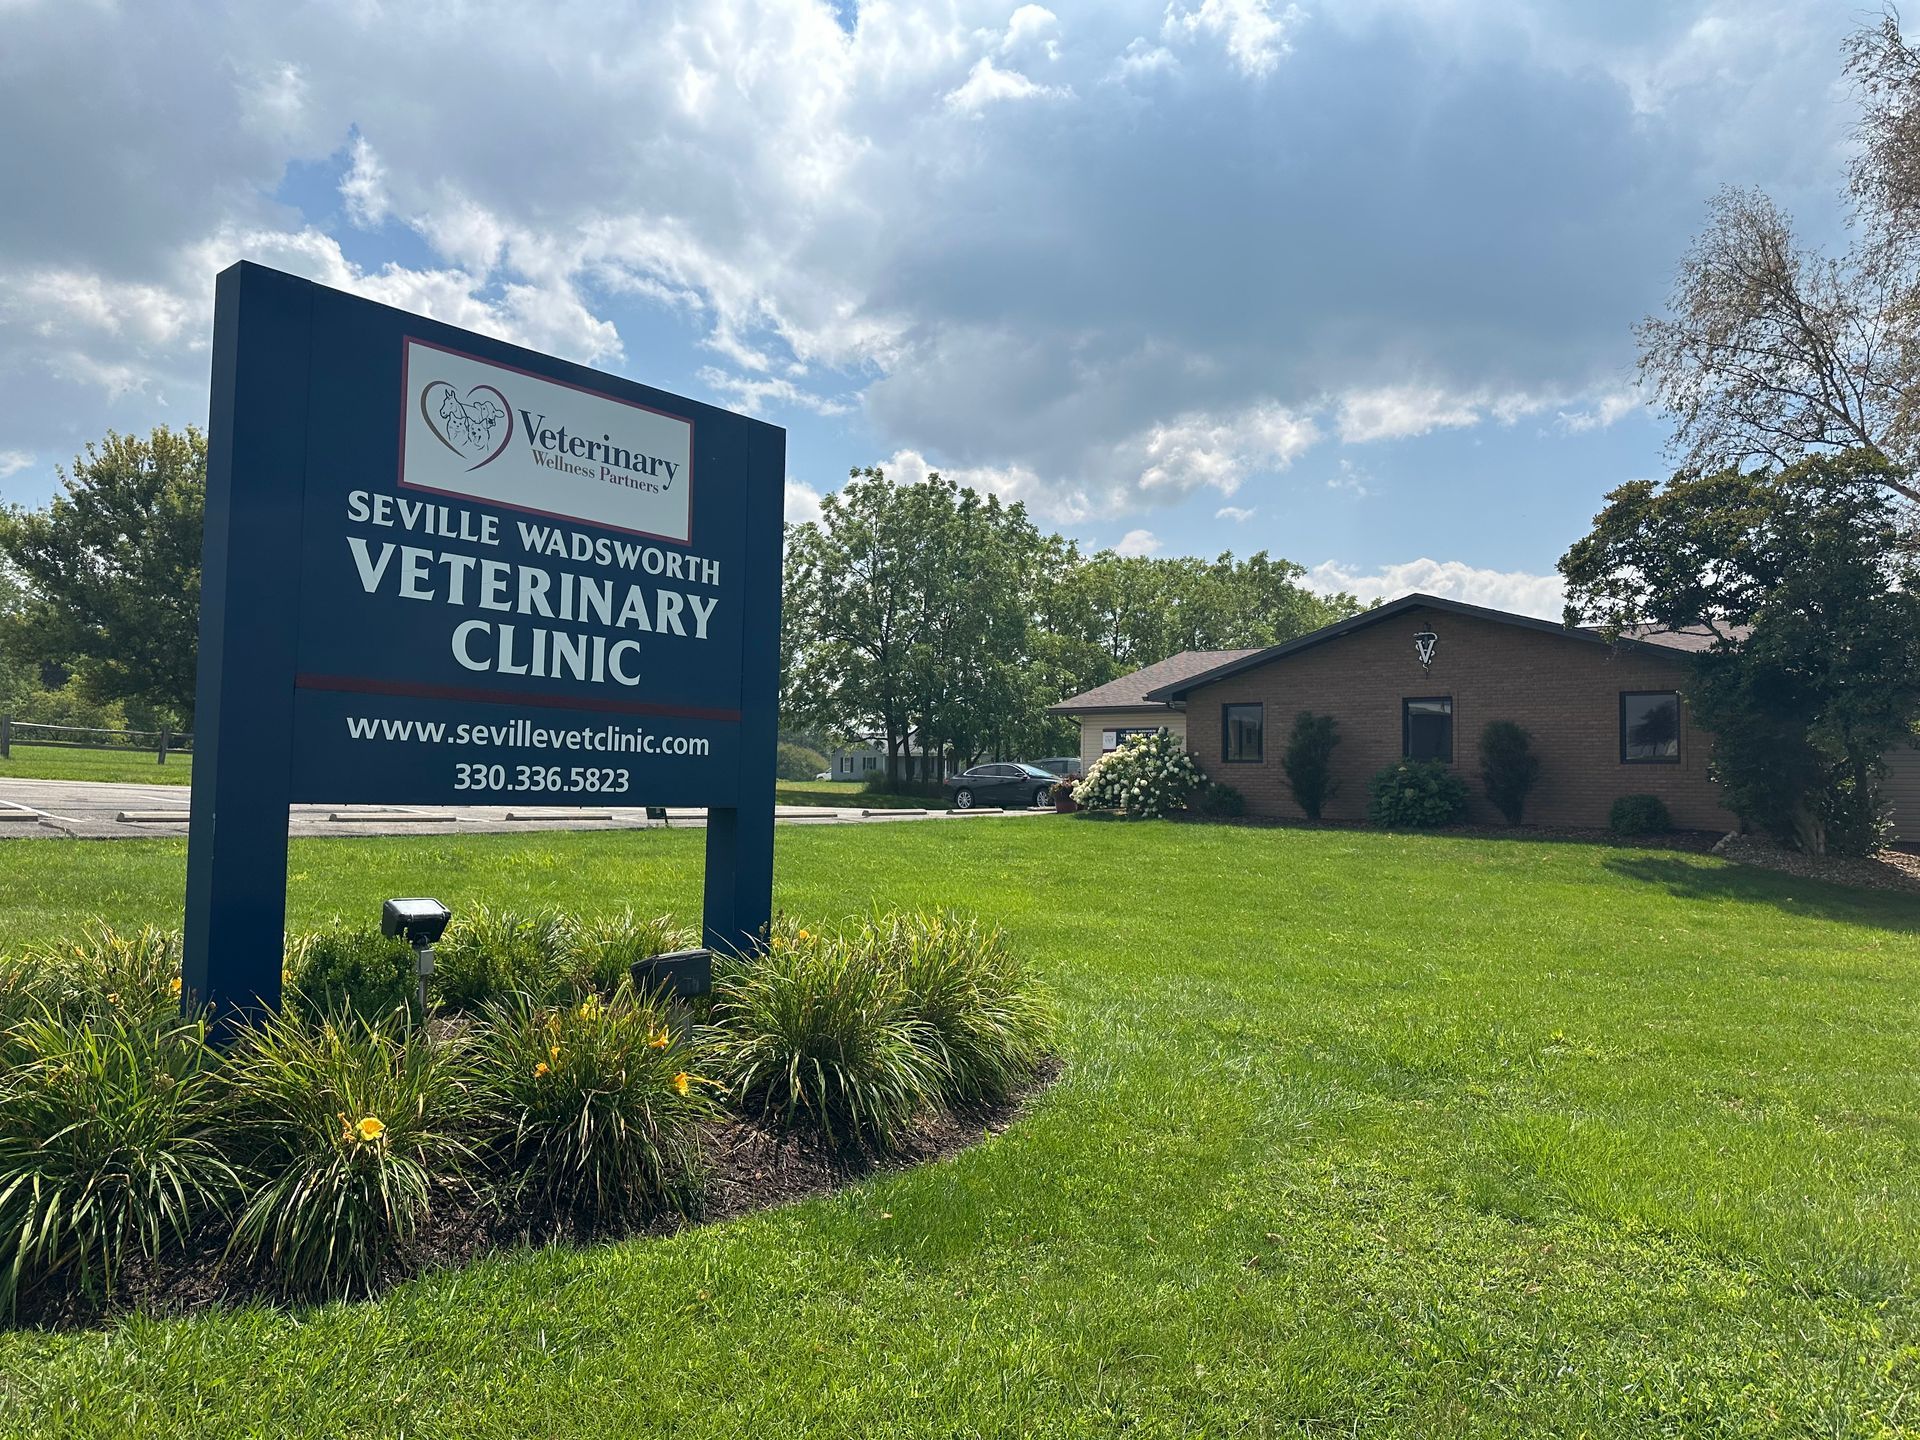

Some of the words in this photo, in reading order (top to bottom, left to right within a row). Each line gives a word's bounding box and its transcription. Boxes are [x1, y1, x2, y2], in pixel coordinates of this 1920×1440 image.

[518, 409, 680, 491] Veterinary
[531, 449, 595, 479] Wellness
[599, 466, 659, 494] Partners
[347, 490, 500, 546] SEVILLE
[517, 521, 721, 586] WADSWORTH
[346, 536, 719, 640] VETERINARY
[451, 619, 641, 685] CLINIC
[346, 717, 709, 756] www.sevillevetclinic.com
[453, 763, 630, 793] 330.336.5823
